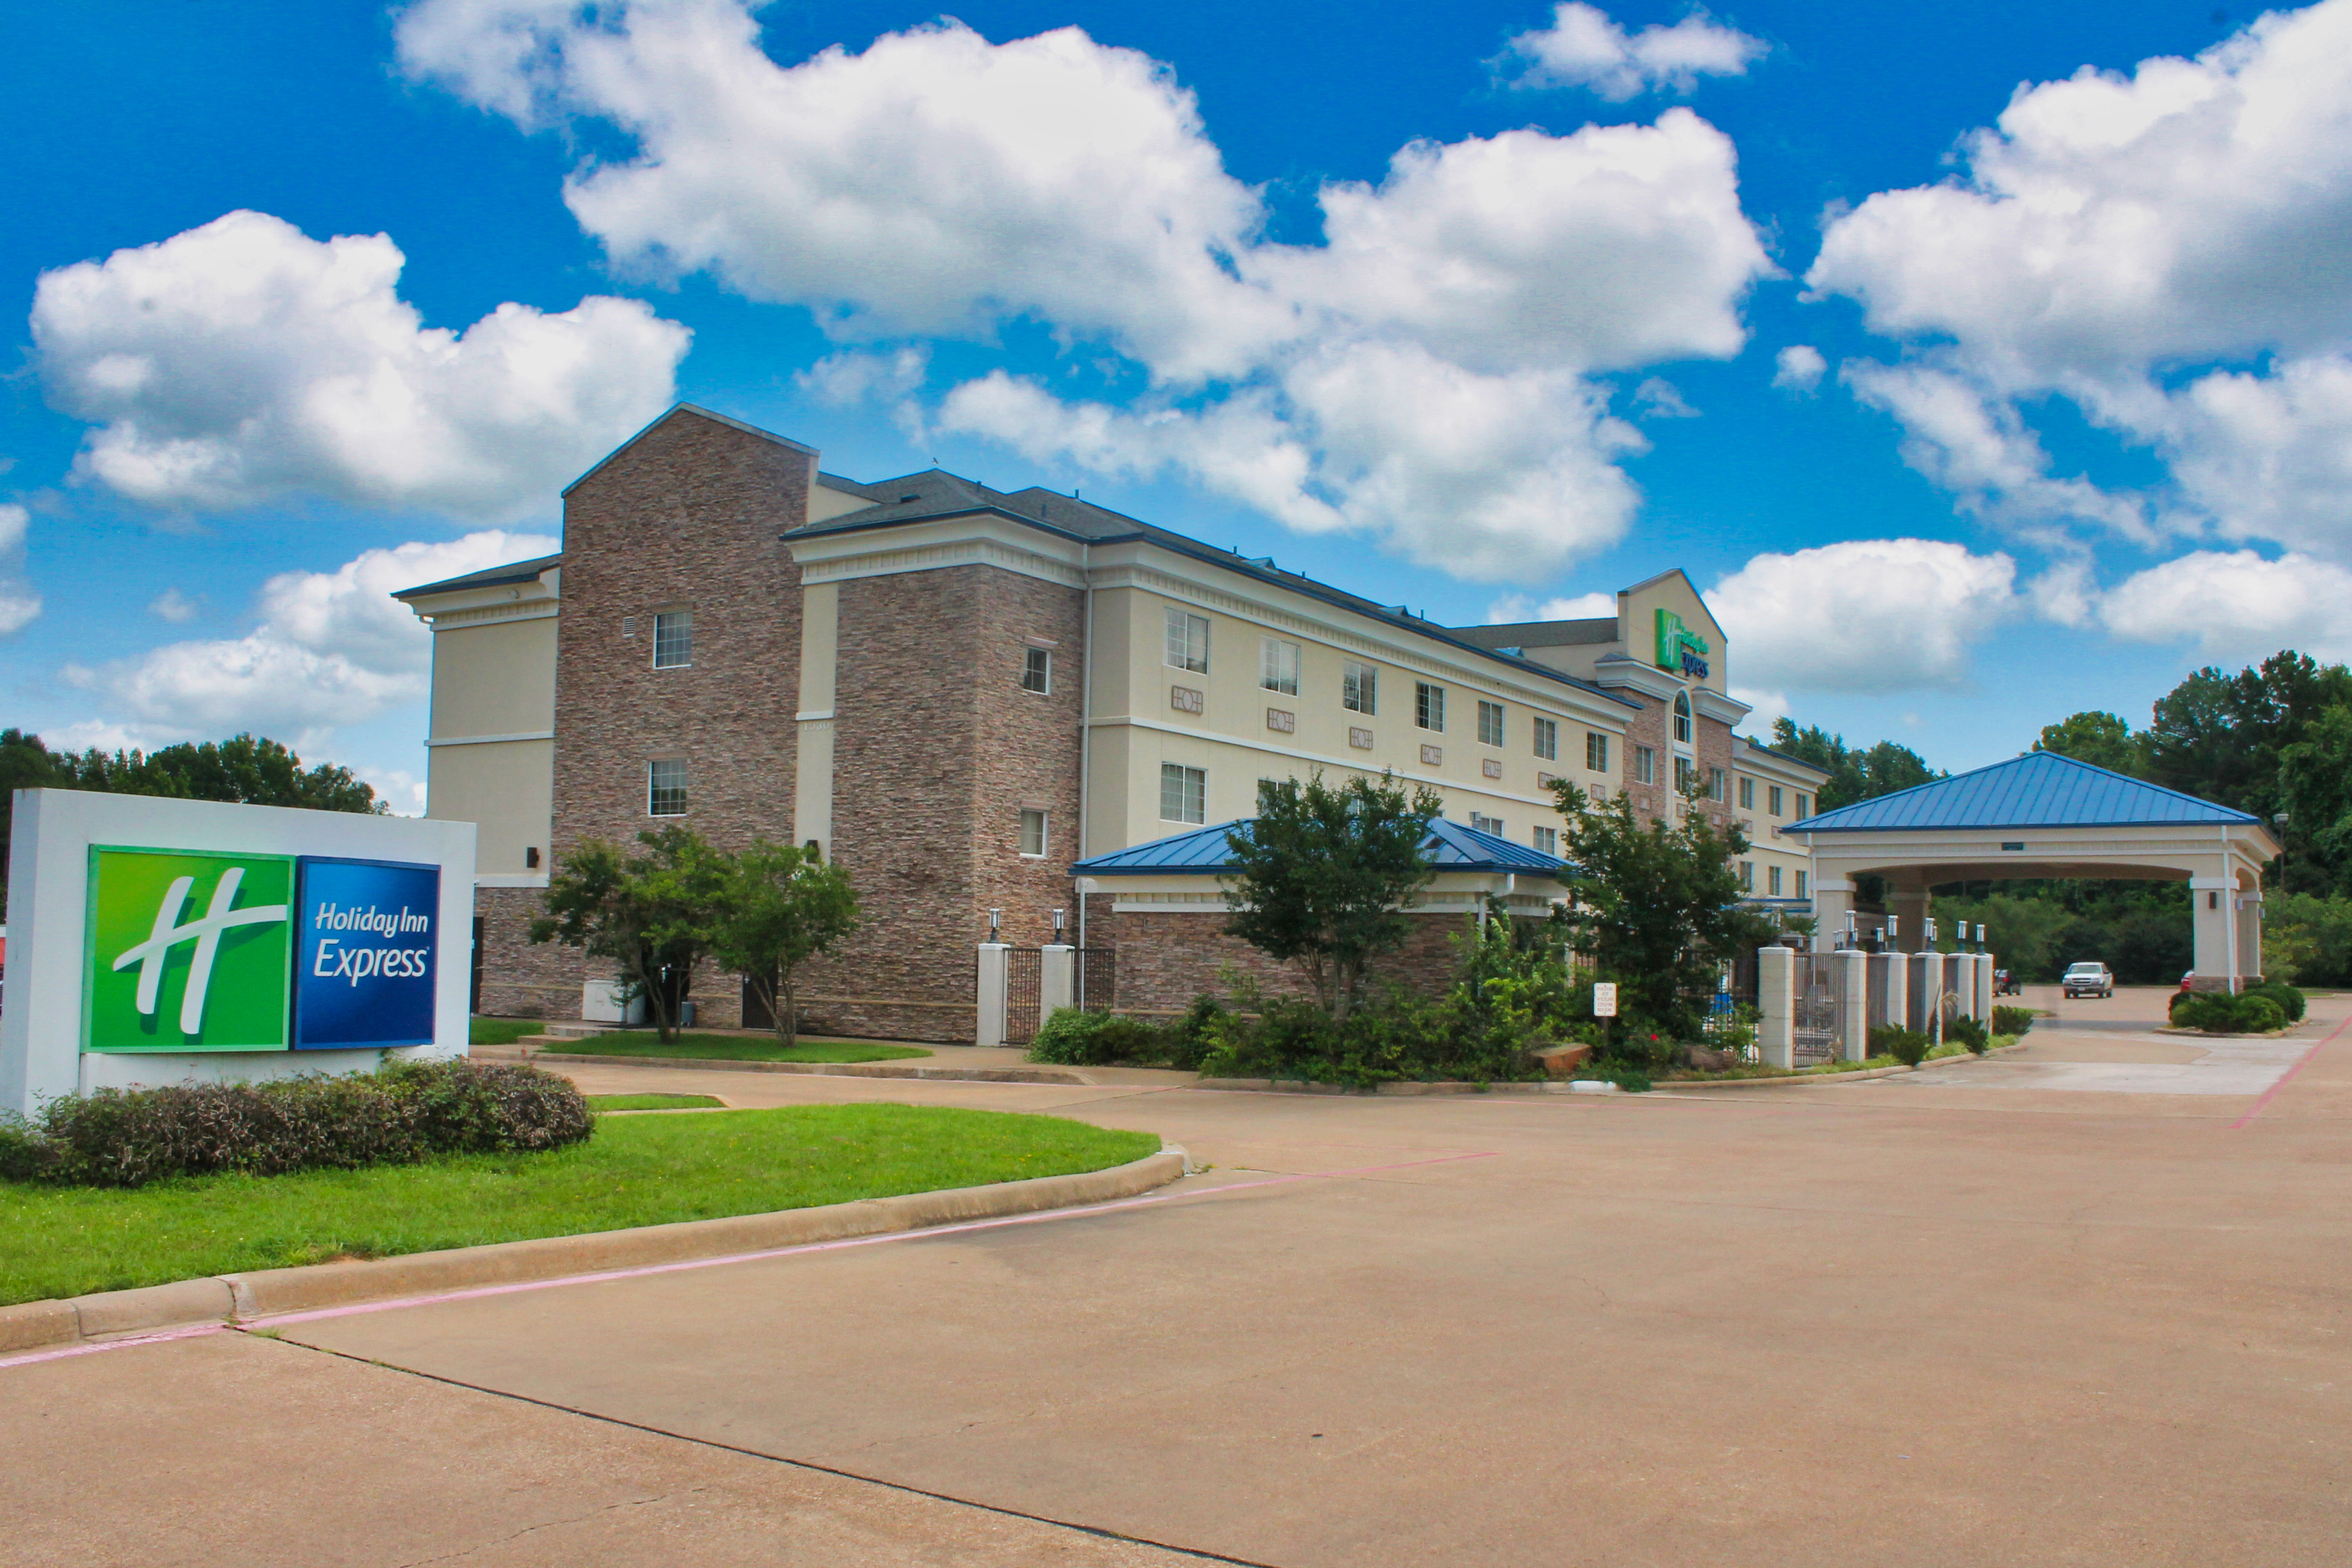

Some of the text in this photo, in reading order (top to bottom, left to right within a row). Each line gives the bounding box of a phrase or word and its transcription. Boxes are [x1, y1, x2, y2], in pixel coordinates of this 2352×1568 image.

[315, 902, 428, 938] Holiday Inn
[314, 938, 427, 987] Express
